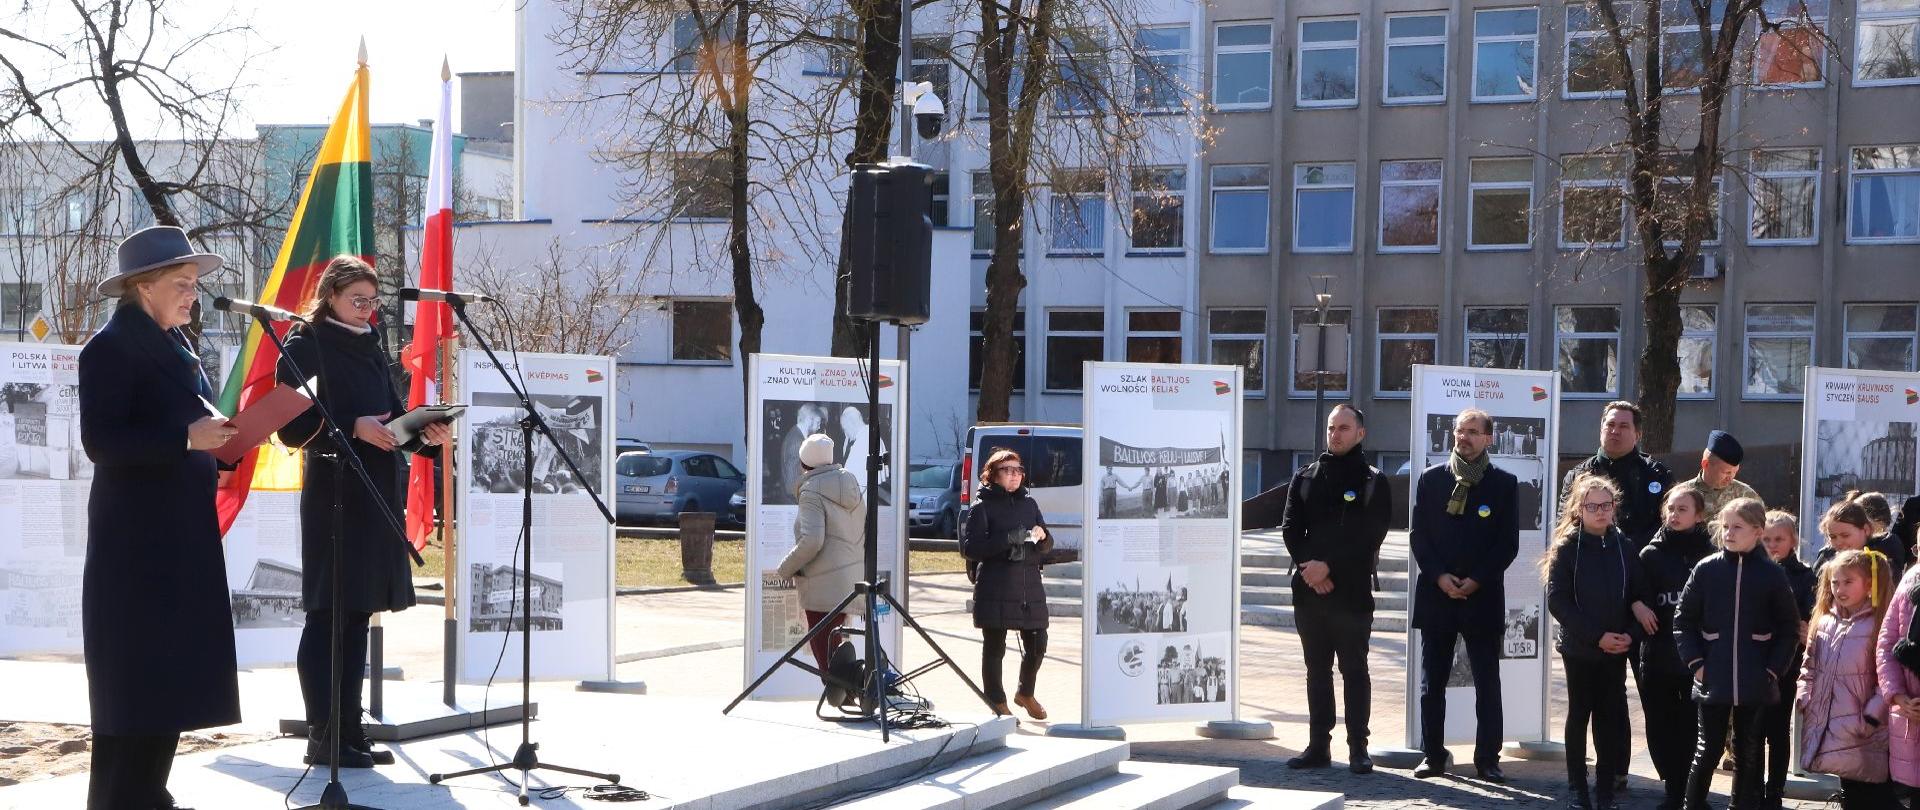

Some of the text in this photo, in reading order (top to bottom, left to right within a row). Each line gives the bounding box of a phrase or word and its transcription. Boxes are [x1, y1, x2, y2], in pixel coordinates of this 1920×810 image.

[12, 352, 47, 361] POLSKA
[18, 362, 47, 370] LITWA
[779, 367, 817, 376] KULTURA
[819, 378, 858, 387] KULTŪRA
[1120, 374, 1147, 383] SZLAK
[1151, 375, 1190, 384] BALTIJOS
[1442, 378, 1471, 387] WOLNA
[1474, 379, 1500, 388] LAISVA
[1825, 382, 1856, 391] KRWAWY
[1857, 383, 1894, 393] KRUVINASIS
[1101, 383, 1148, 394] WOLNOŚCI
[1151, 384, 1180, 394] KELIAS
[1446, 389, 1471, 399] LITWA
[1473, 390, 1505, 400] LIETUVA
[1826, 391, 1855, 403] STYCZEŃ
[1856, 394, 1880, 404] SAUSIS
[1113, 445, 1156, 465] BALTIJOS
